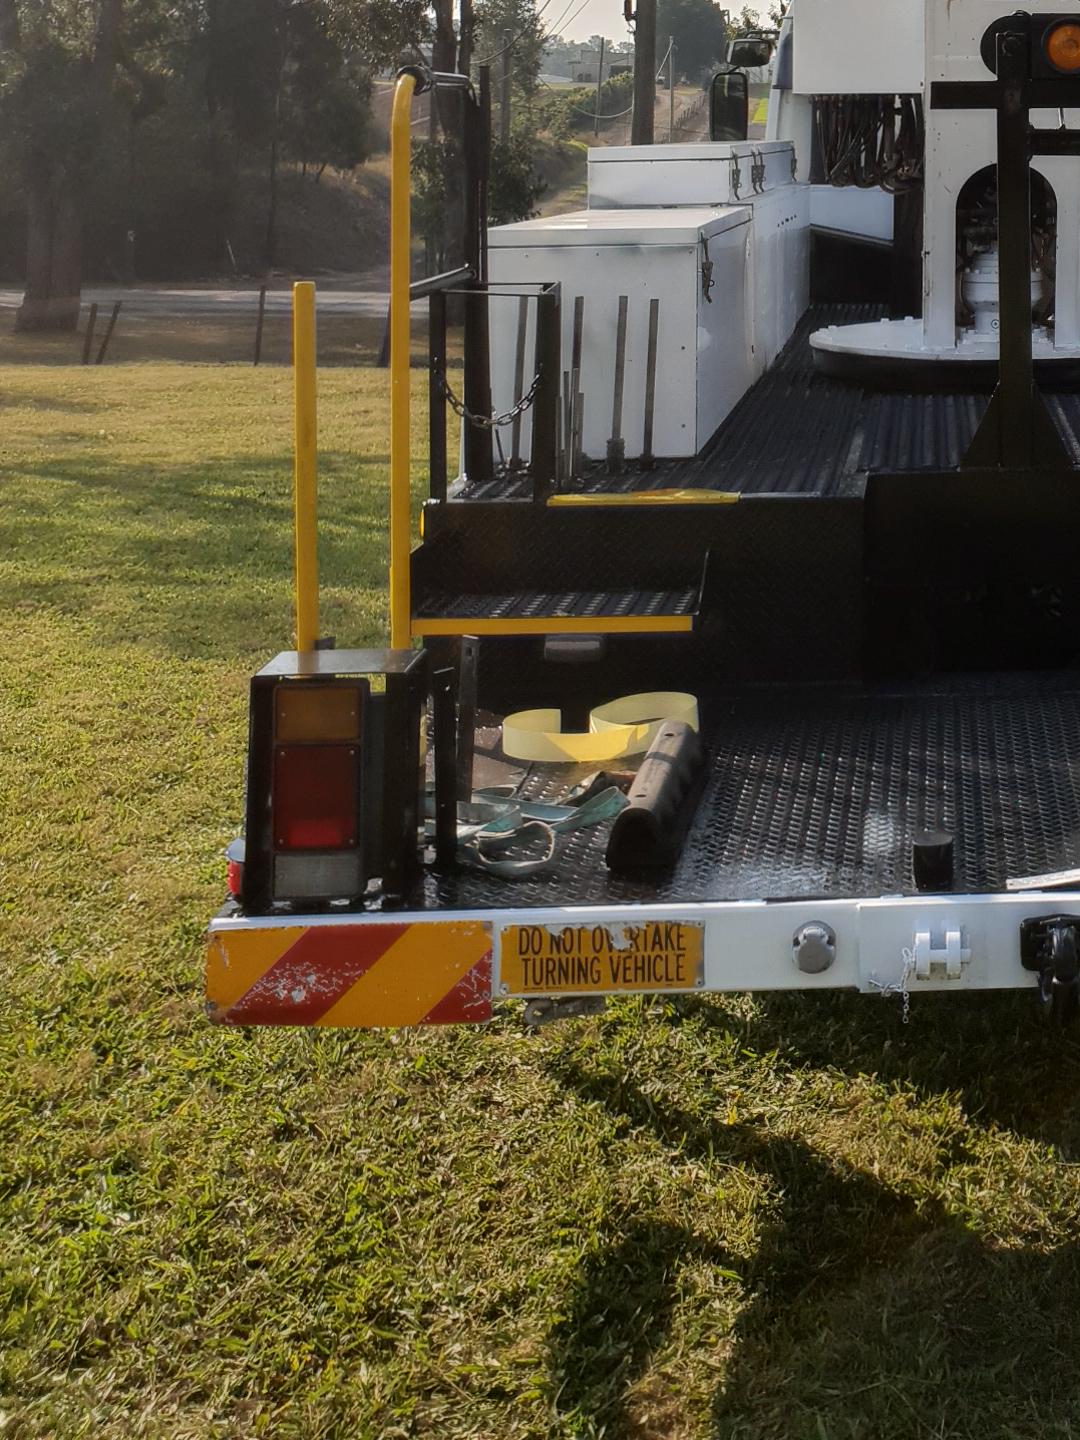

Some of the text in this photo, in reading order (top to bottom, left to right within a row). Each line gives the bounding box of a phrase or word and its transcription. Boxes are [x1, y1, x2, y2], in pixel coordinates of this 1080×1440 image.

[518, 924, 687, 956] DO NOT OVRTAKE
[523, 954, 686, 986] TURNING VEHICLE
